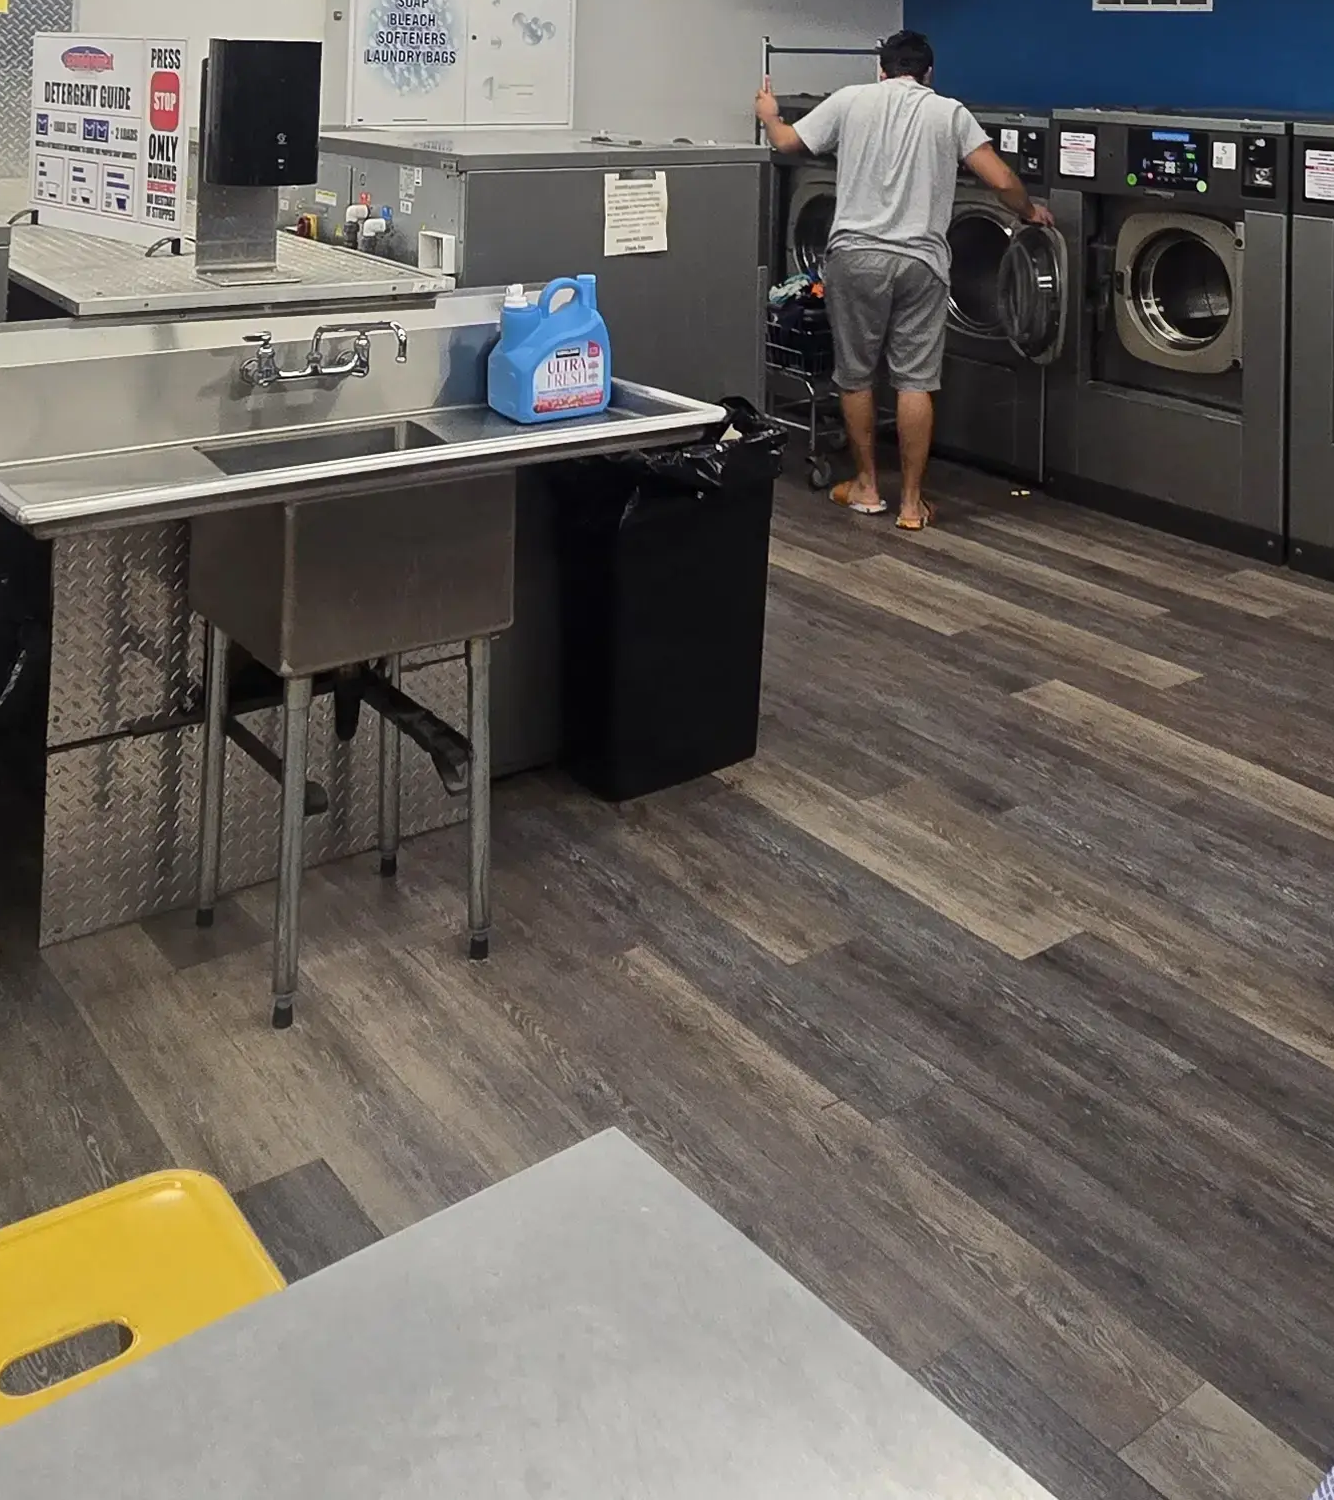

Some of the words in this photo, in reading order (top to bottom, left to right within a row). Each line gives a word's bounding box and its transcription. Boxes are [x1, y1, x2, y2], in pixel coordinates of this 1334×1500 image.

[389, 13, 436, 27] BLEACH
[377, 31, 446, 46] SOFTENERS
[150, 48, 181, 69] PRESS
[366, 50, 422, 64] LAUNDRY
[425, 51, 457, 65] BAGS
[44, 81, 98, 108] DETERGENT
[100, 86, 131, 110] GUIDE
[153, 91, 176, 112] STOP
[148, 133, 178, 163] ONLY
[147, 162, 177, 182] DURING
[548, 357, 586, 374] ULTRA
[548, 370, 586, 388] FRESH
